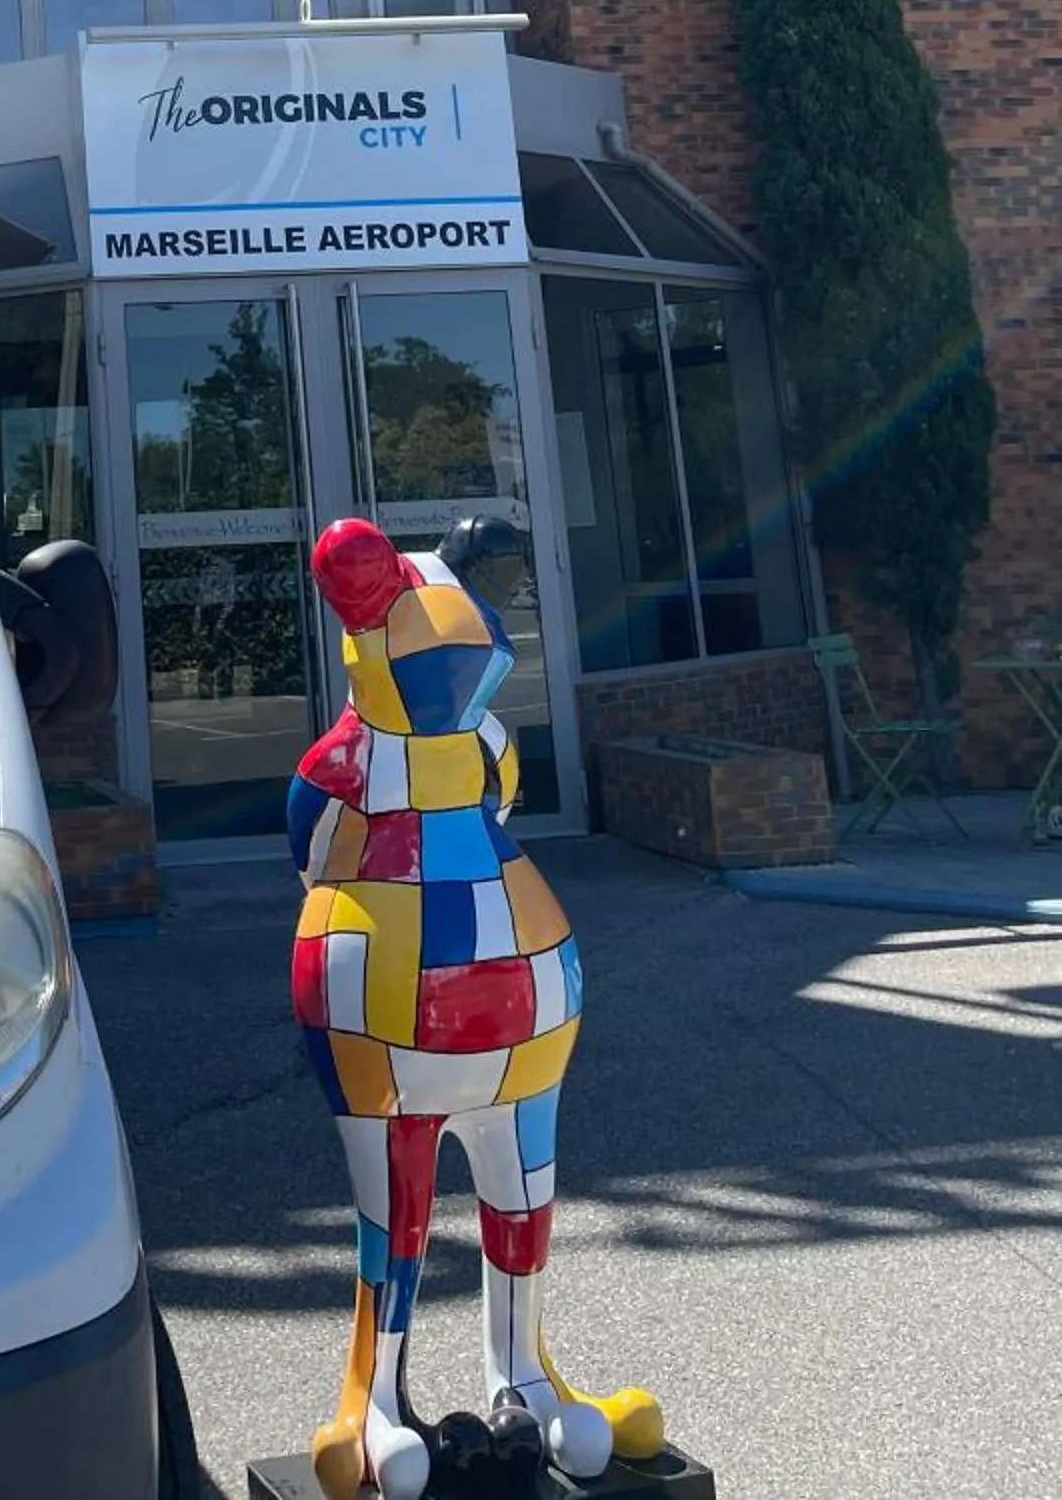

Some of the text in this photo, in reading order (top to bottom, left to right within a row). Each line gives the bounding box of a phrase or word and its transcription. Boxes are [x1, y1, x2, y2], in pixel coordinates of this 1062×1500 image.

[138, 76, 427, 141] The ORIGINALS
[359, 125, 427, 149] CITY
[105, 219, 511, 259] MARSEILLE AEROPORT
